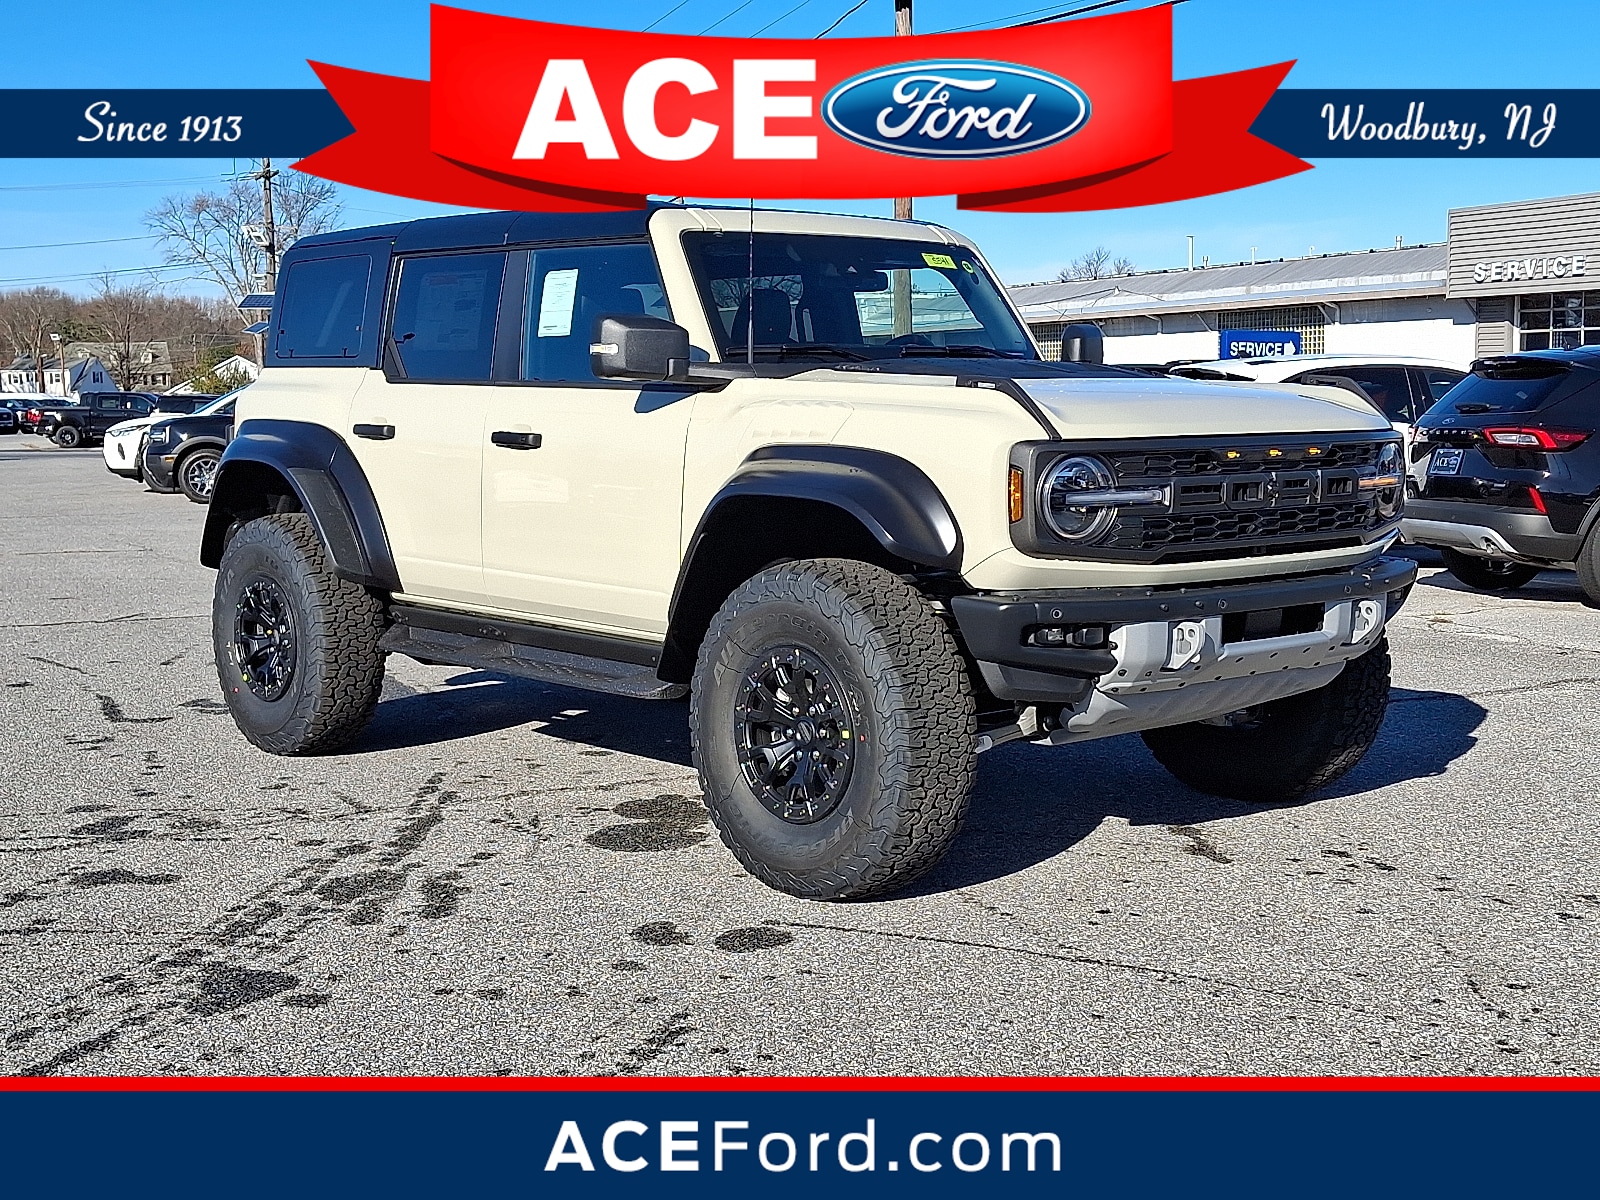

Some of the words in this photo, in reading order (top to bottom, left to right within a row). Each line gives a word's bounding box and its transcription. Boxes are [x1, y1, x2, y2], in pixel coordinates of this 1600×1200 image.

[1473, 254, 1585, 283] SERVICE
[1230, 341, 1283, 357] SERVICE
[1172, 467, 1360, 514] FORD
